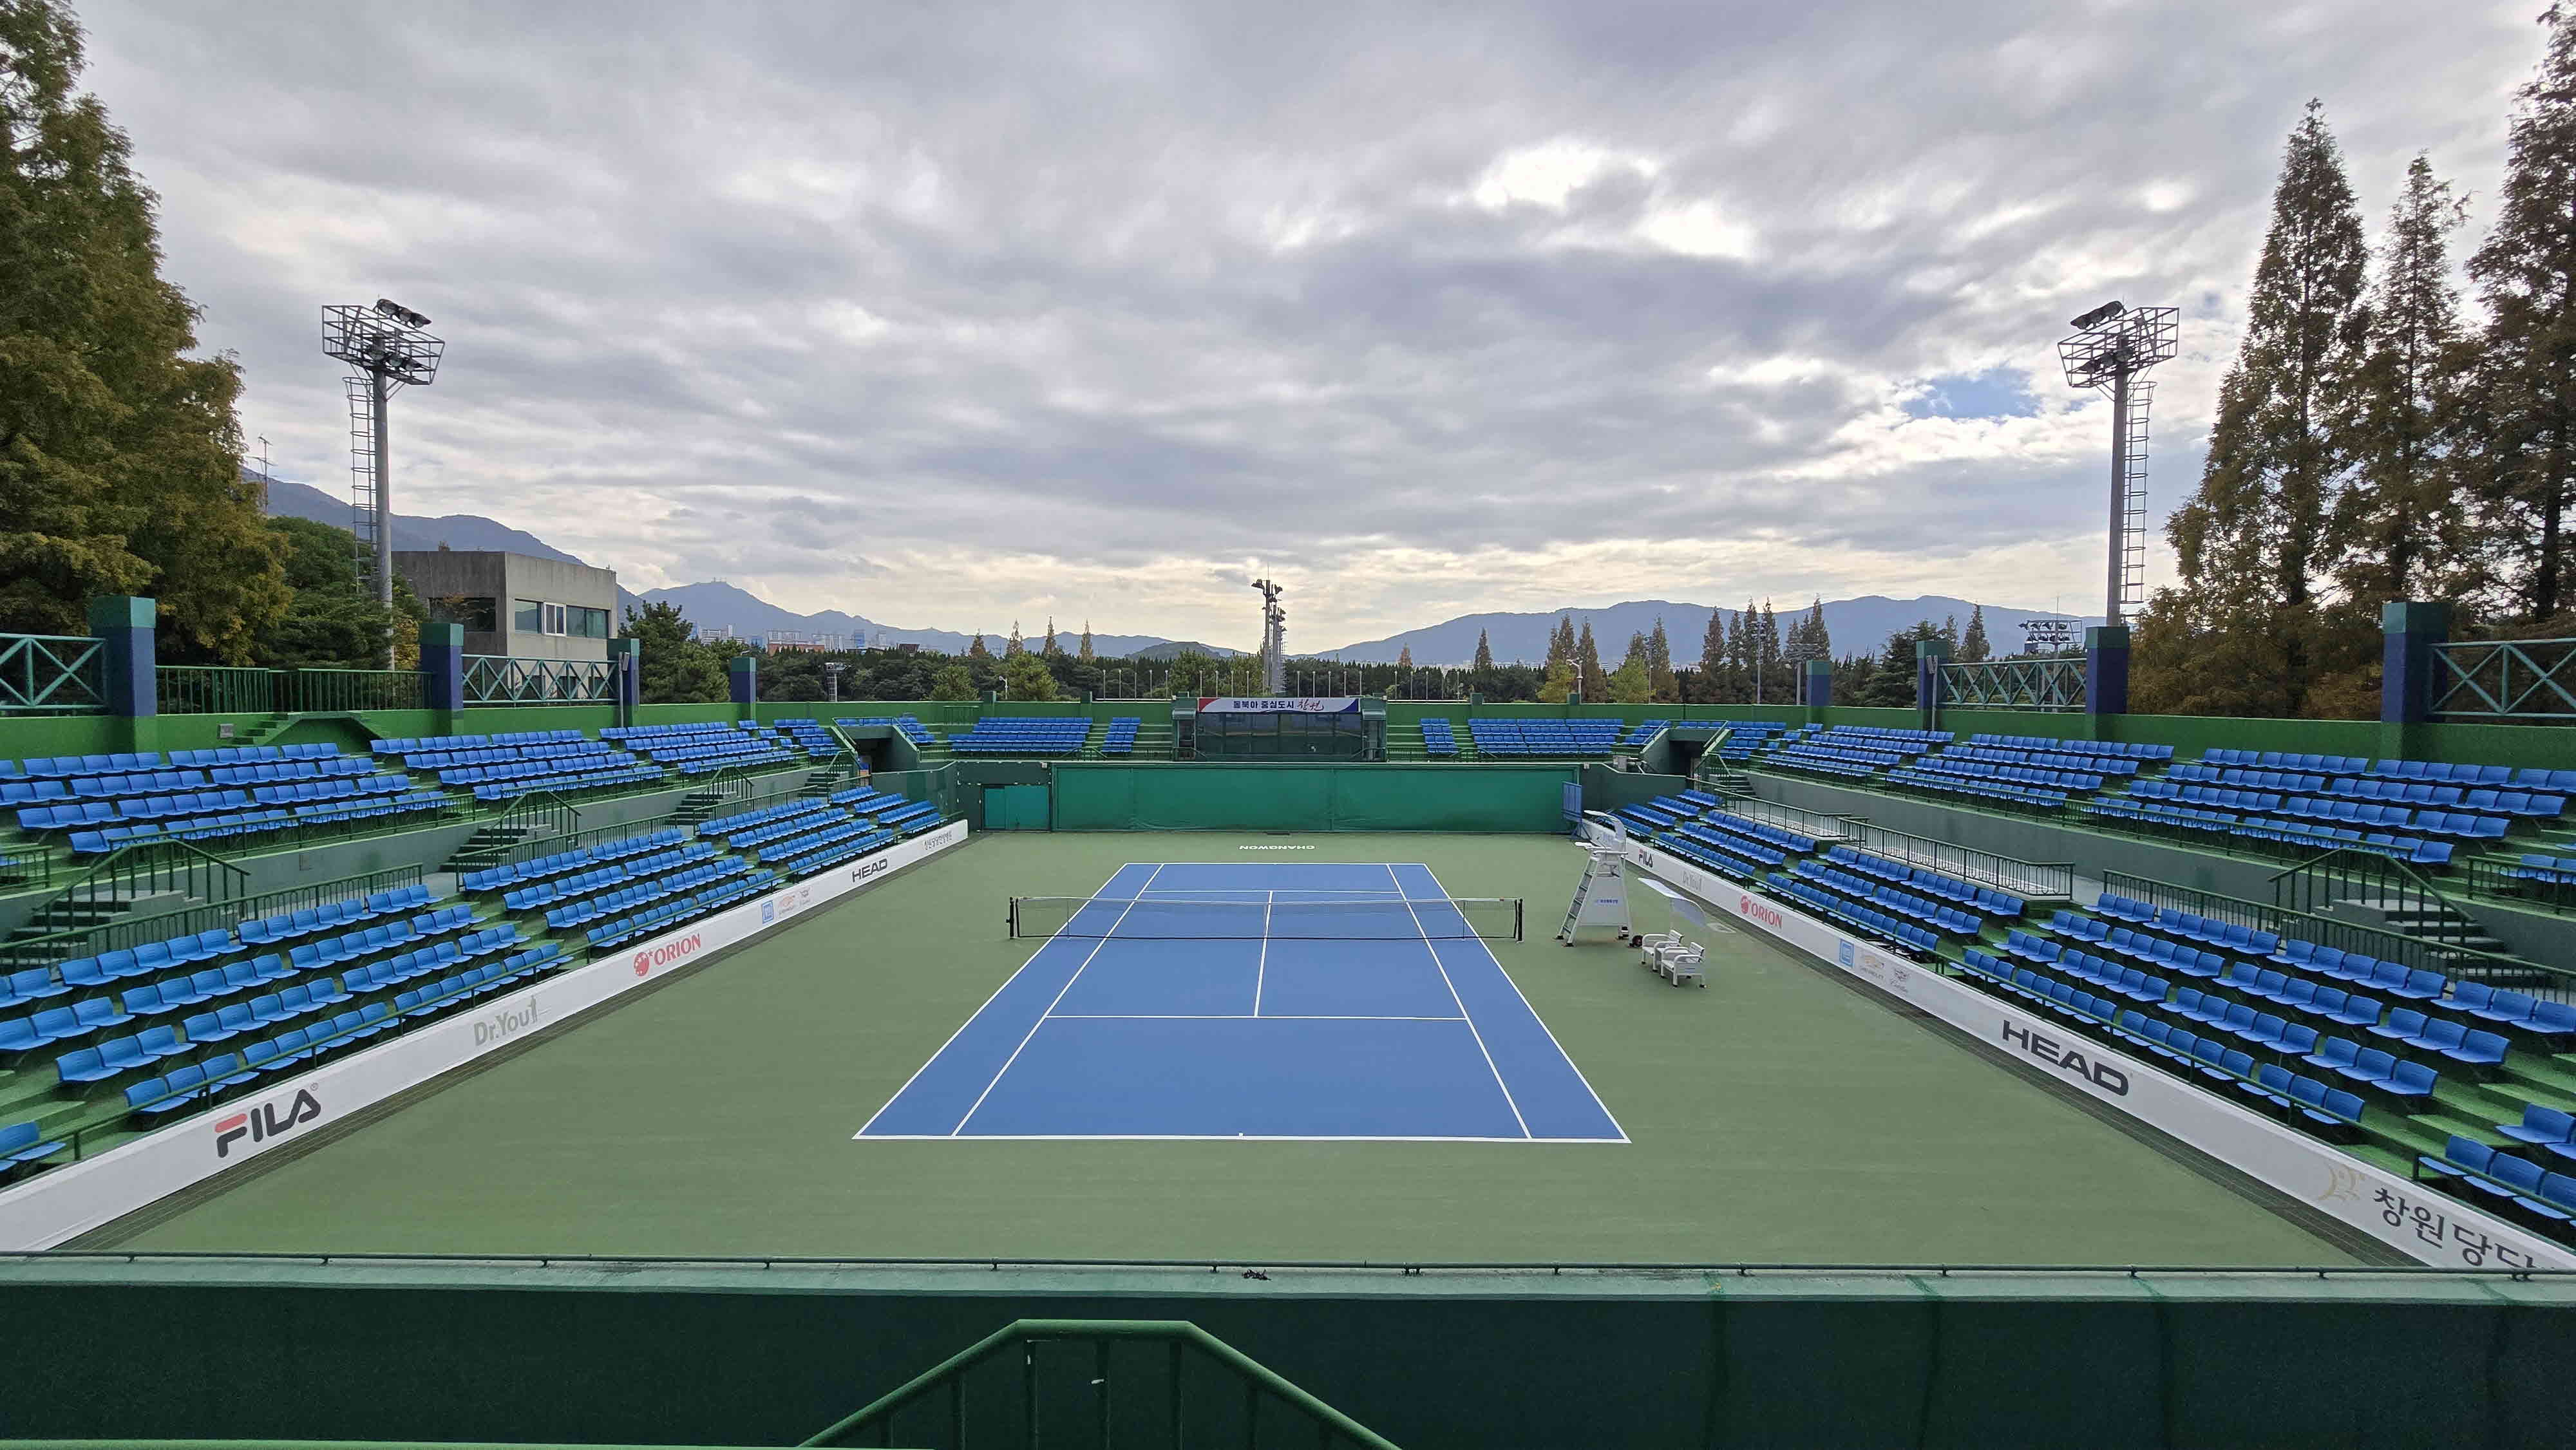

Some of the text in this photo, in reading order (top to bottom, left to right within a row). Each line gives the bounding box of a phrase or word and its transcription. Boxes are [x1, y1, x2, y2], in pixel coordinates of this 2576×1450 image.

[1260, 700, 1294, 709] 중심도시
[852, 858, 887, 882] HEAD
[1638, 849, 1653, 867] FILA
[1751, 903, 1782, 929] ORION
[654, 934, 701, 965] ORION
[474, 1010, 530, 1046] Dr.You
[2002, 1019, 2129, 1097] HEAD
[214, 1088, 321, 1158] FILA
